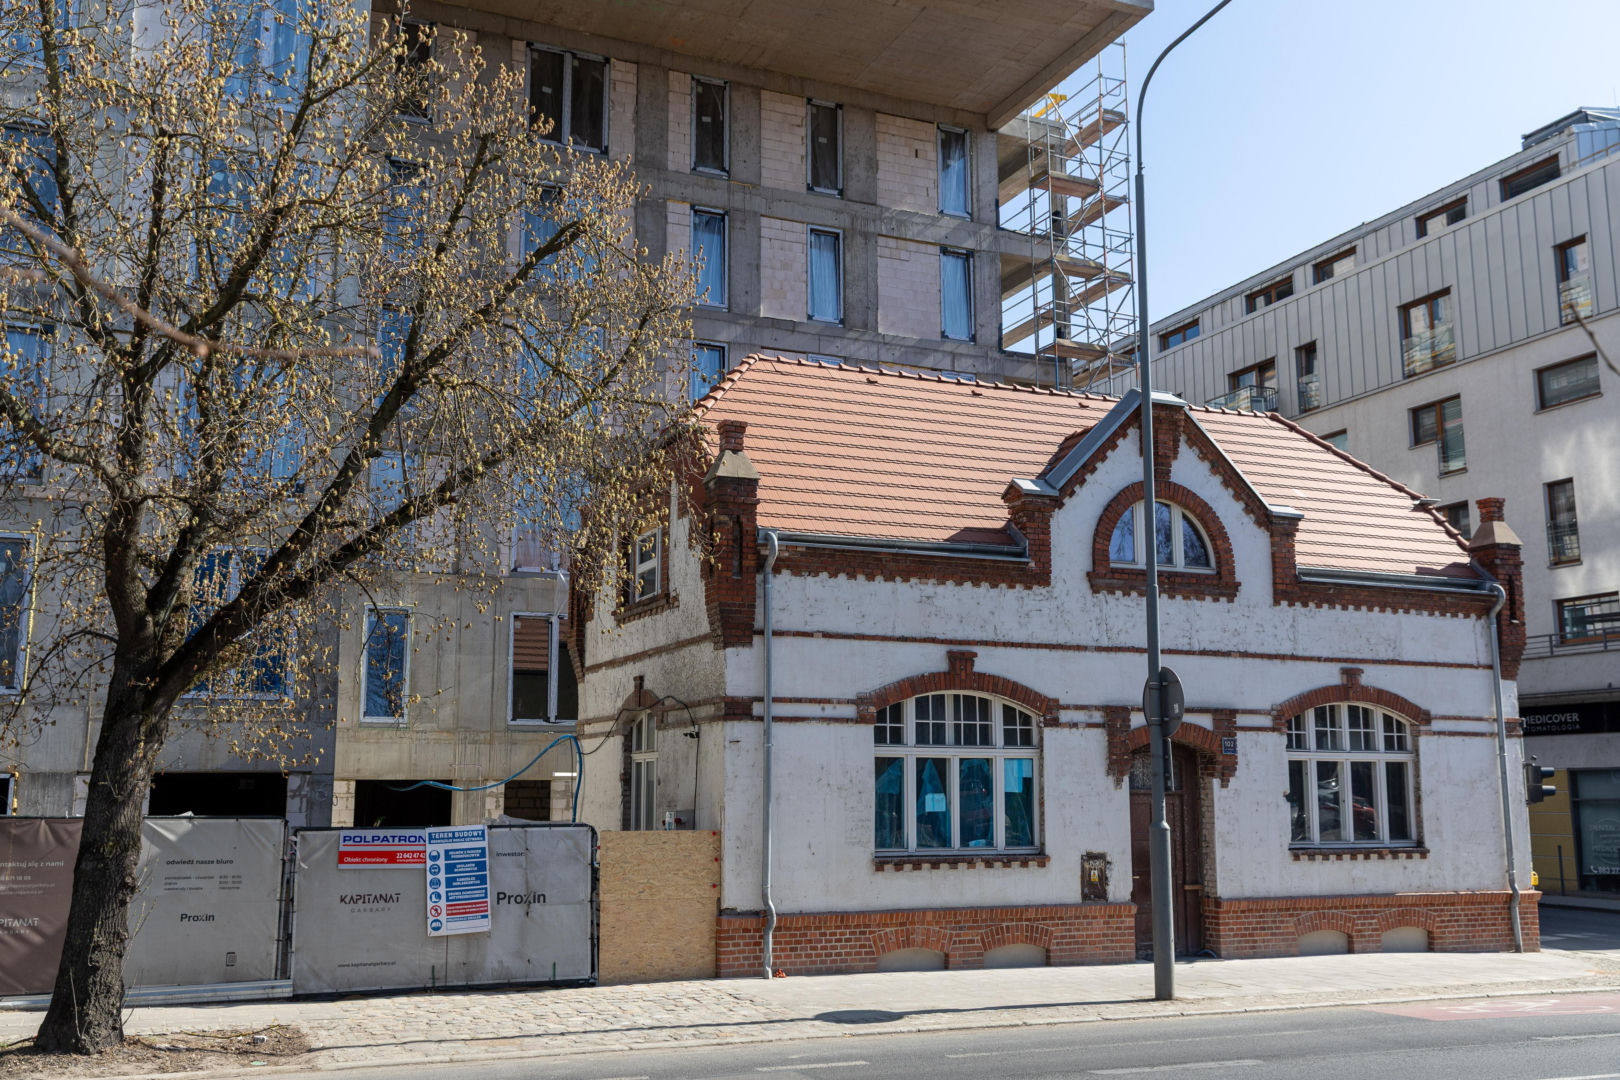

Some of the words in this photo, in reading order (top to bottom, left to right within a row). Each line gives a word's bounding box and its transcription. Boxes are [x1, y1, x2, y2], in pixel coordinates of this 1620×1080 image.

[1526, 724, 1580, 732] TOMATOLOGIA
[454, 830, 483, 838] BUDOWY
[343, 835, 426, 844] POLPATRON
[340, 893, 401, 905] KAPITANAT
[496, 891, 547, 905] Proxin
[180, 913, 215, 922] Proxin
